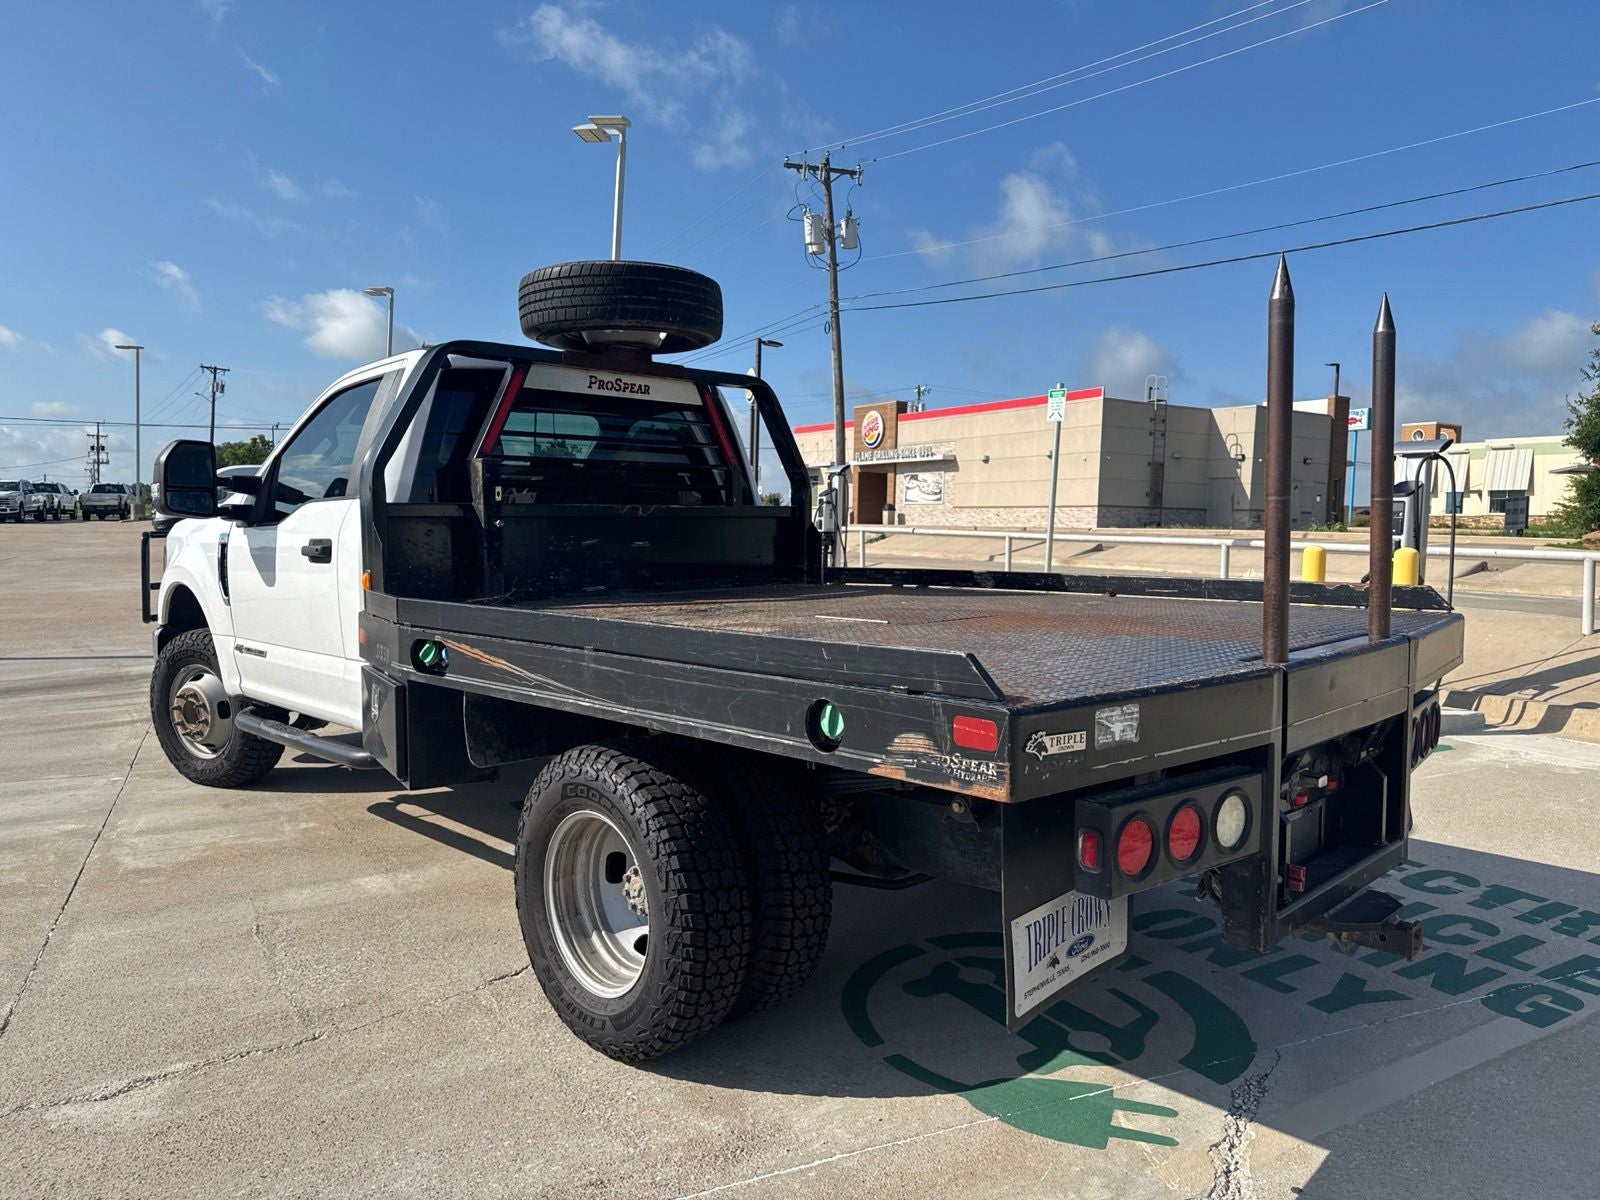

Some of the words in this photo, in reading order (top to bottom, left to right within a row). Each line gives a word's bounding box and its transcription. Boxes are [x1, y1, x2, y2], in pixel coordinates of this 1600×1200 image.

[1049, 732, 1086, 748] TRIPLE
[1057, 744, 1075, 752] CROWN
[1025, 905, 1068, 974] TRIPLE
[1071, 896, 1111, 937] CROWN
[1132, 909, 1414, 1014] ONLY
